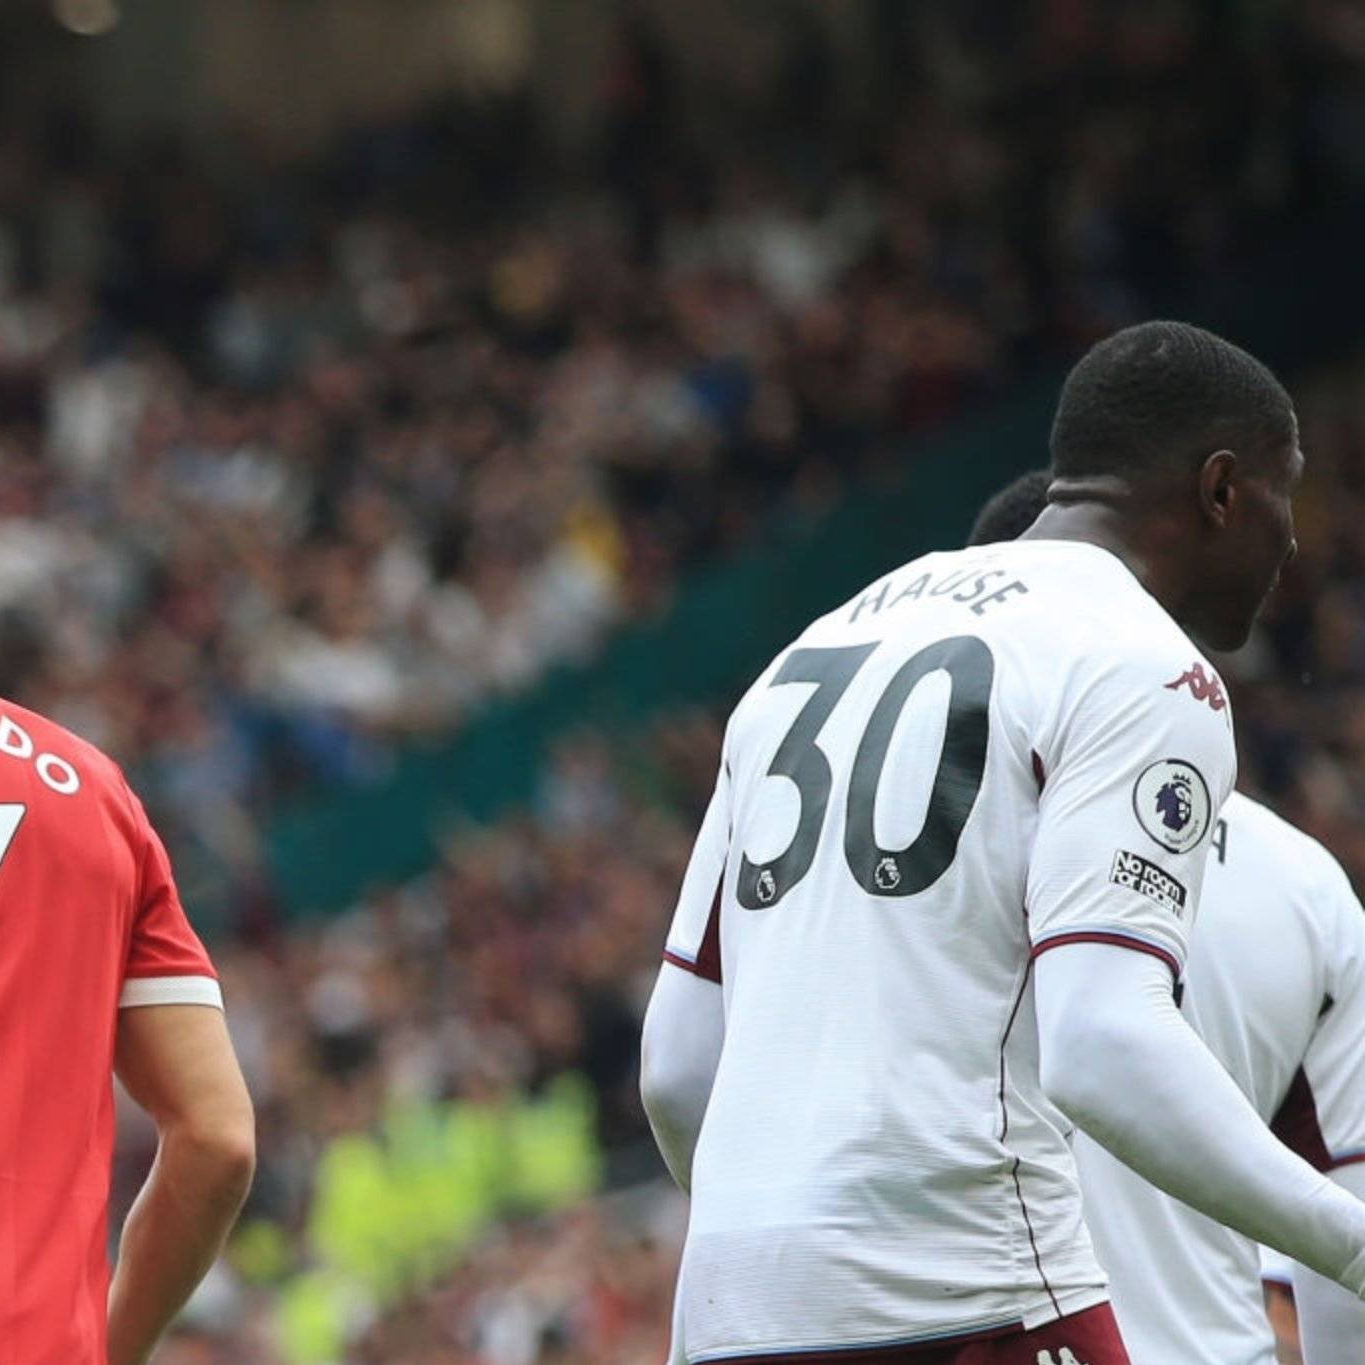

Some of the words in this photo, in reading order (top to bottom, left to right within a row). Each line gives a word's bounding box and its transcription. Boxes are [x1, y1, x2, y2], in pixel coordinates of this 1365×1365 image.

[848, 569, 1030, 624] HAUSE
[736, 635, 994, 910] 30
[1115, 851, 1143, 875] No
[1142, 864, 1181, 902] room
